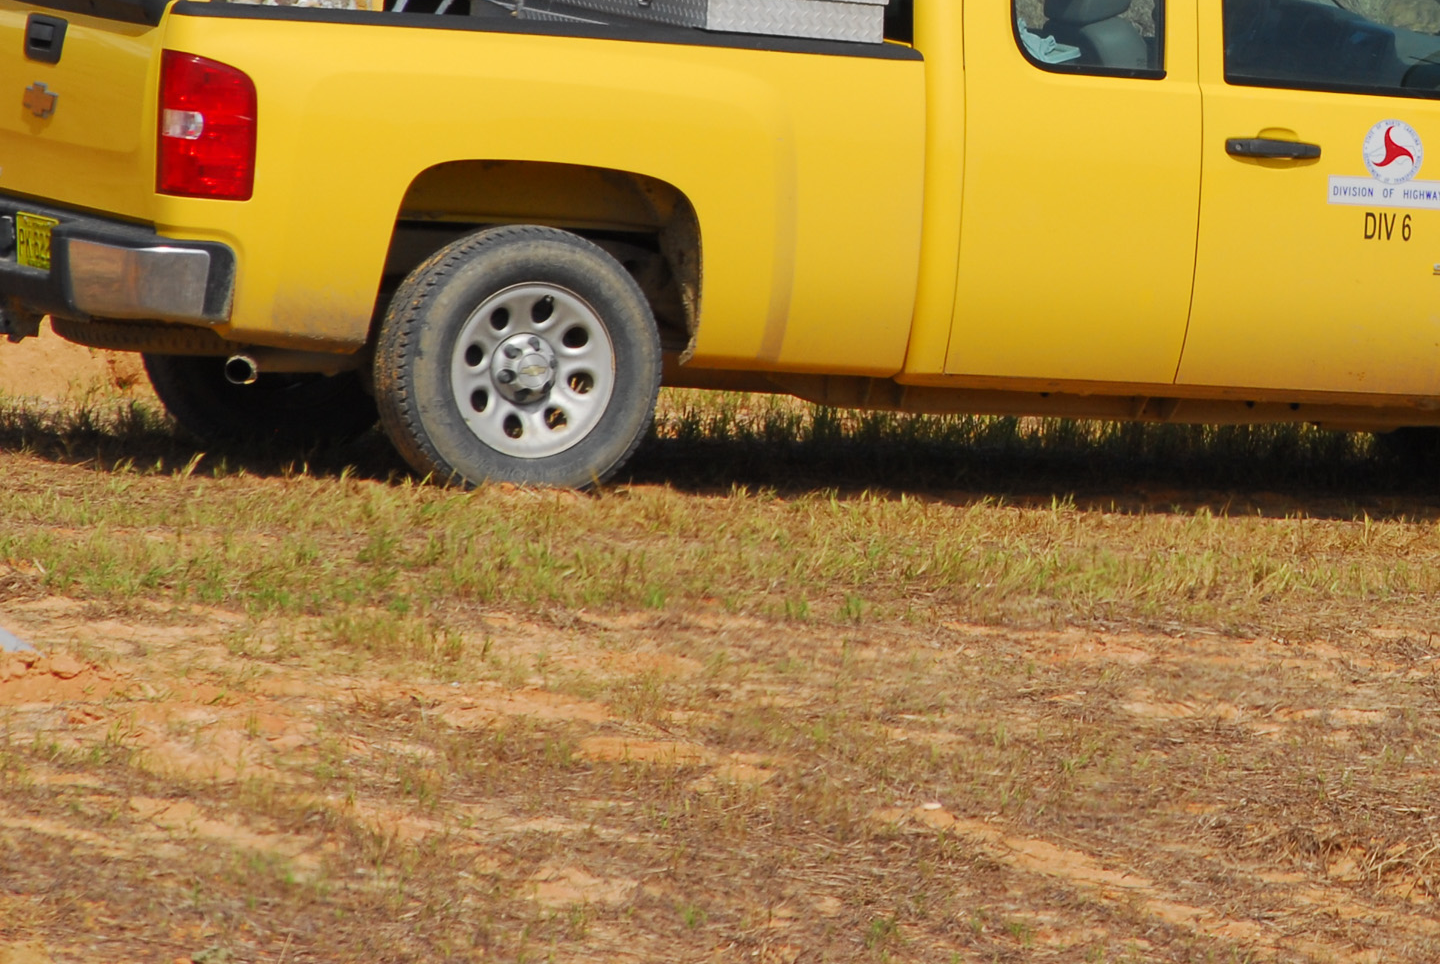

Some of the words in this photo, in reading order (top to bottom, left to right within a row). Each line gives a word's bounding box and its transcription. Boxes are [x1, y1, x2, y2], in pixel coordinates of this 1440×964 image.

[1333, 185, 1374, 198] DIVISION
[1382, 188, 1395, 199] OF
[1364, 211, 1396, 241] DIV
[1401, 213, 1412, 242] 6
